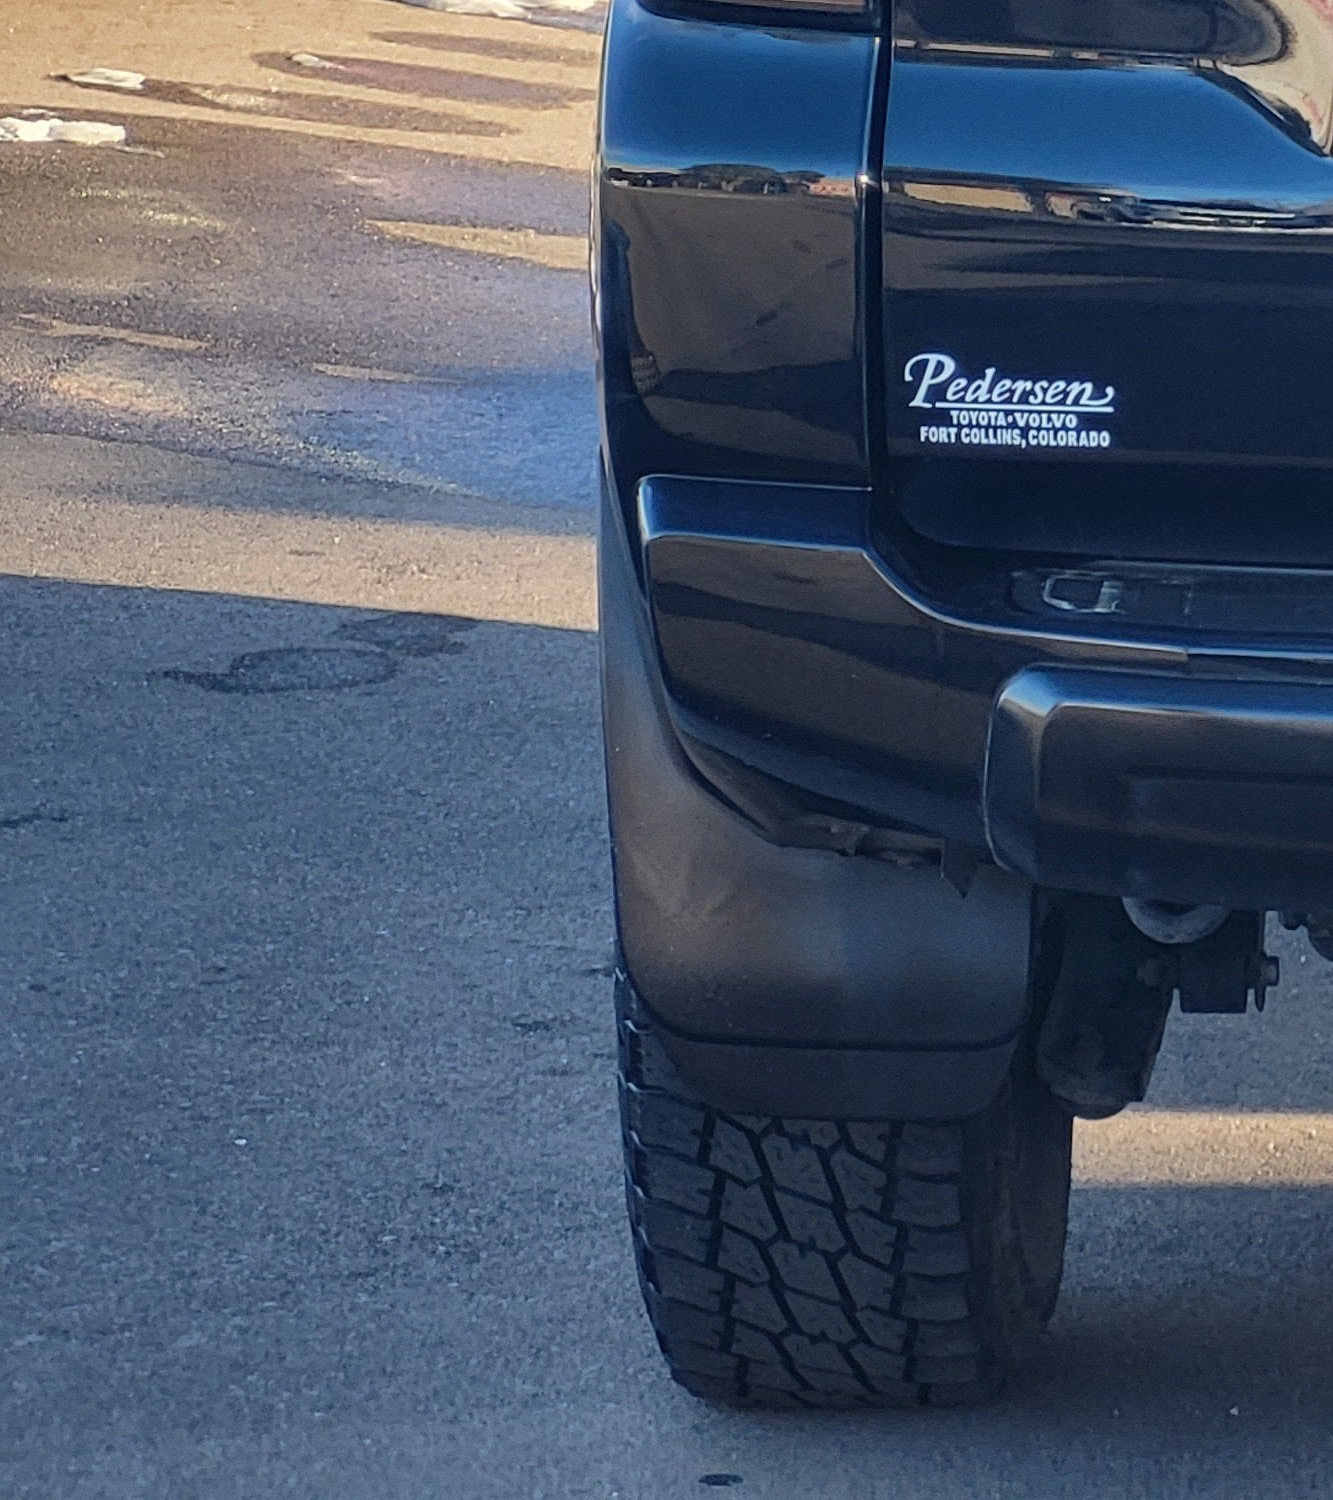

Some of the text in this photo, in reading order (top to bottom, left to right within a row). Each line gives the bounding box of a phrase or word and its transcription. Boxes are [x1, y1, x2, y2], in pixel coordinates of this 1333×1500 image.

[904, 352, 1115, 410] Pedersen
[920, 426, 1111, 449] FORT COLLINS, COLORADO
